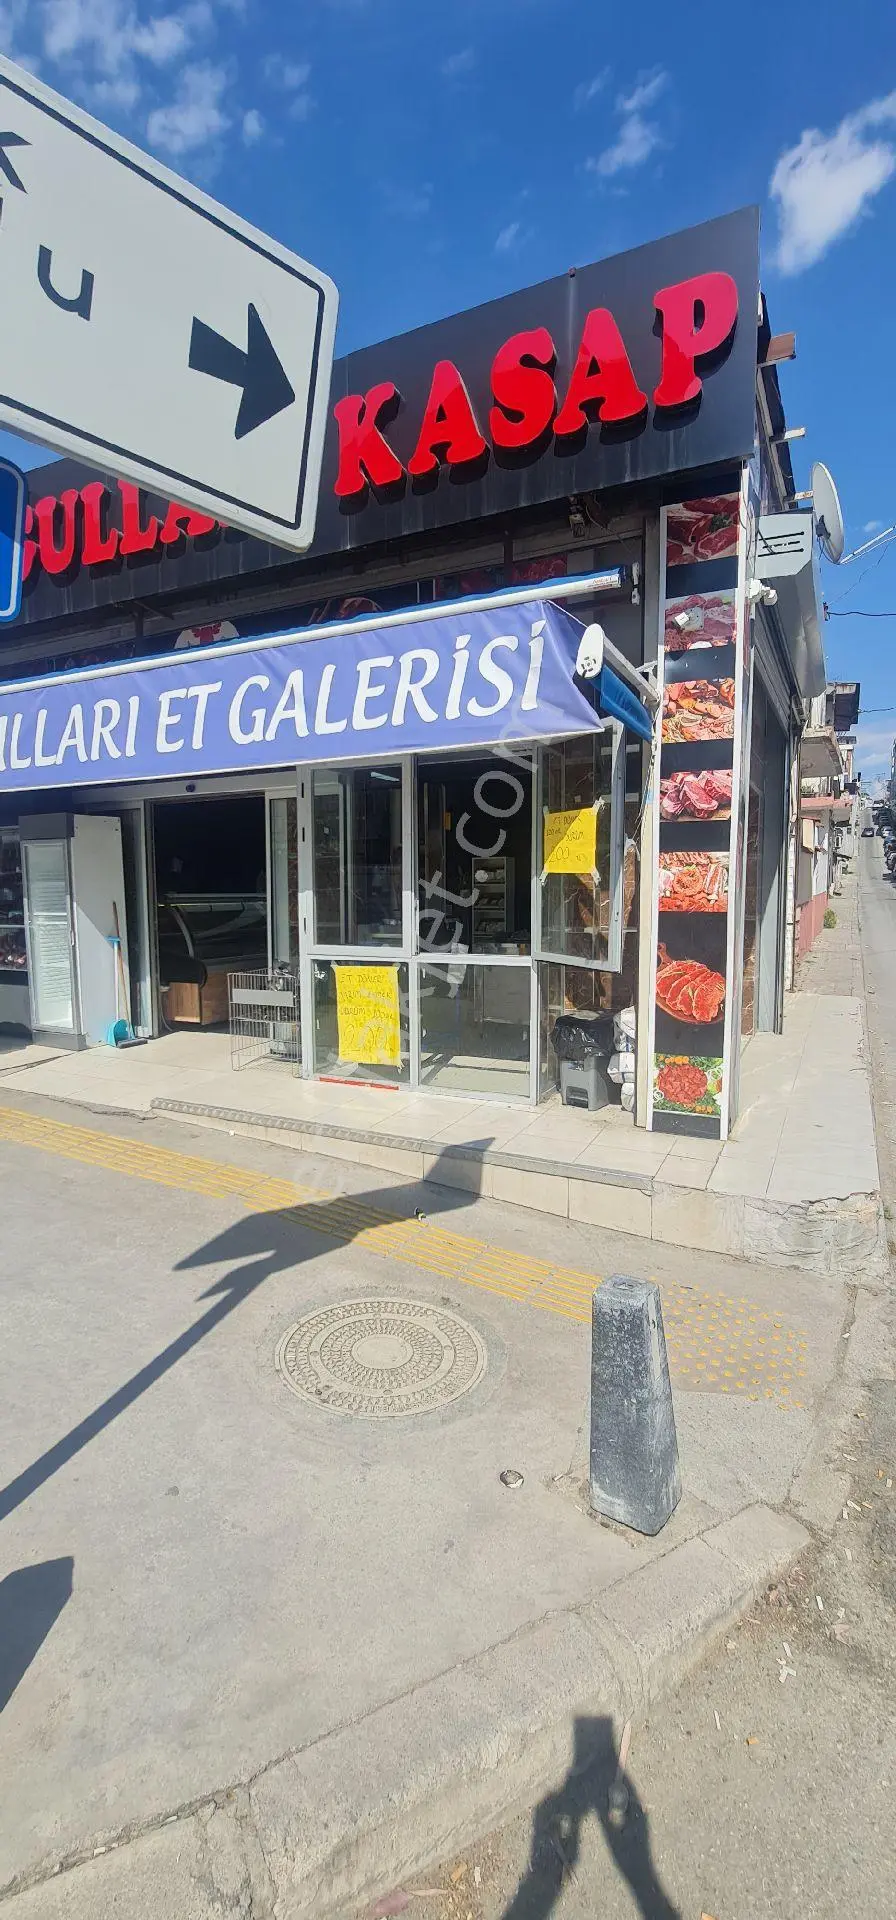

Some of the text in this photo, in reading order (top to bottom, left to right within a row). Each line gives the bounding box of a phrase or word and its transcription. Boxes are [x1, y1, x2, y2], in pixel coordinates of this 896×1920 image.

[22, 272, 739, 582] ULLA KASAP
[156, 680, 223, 753] ET
[228, 619, 547, 745] GALERİSİ
